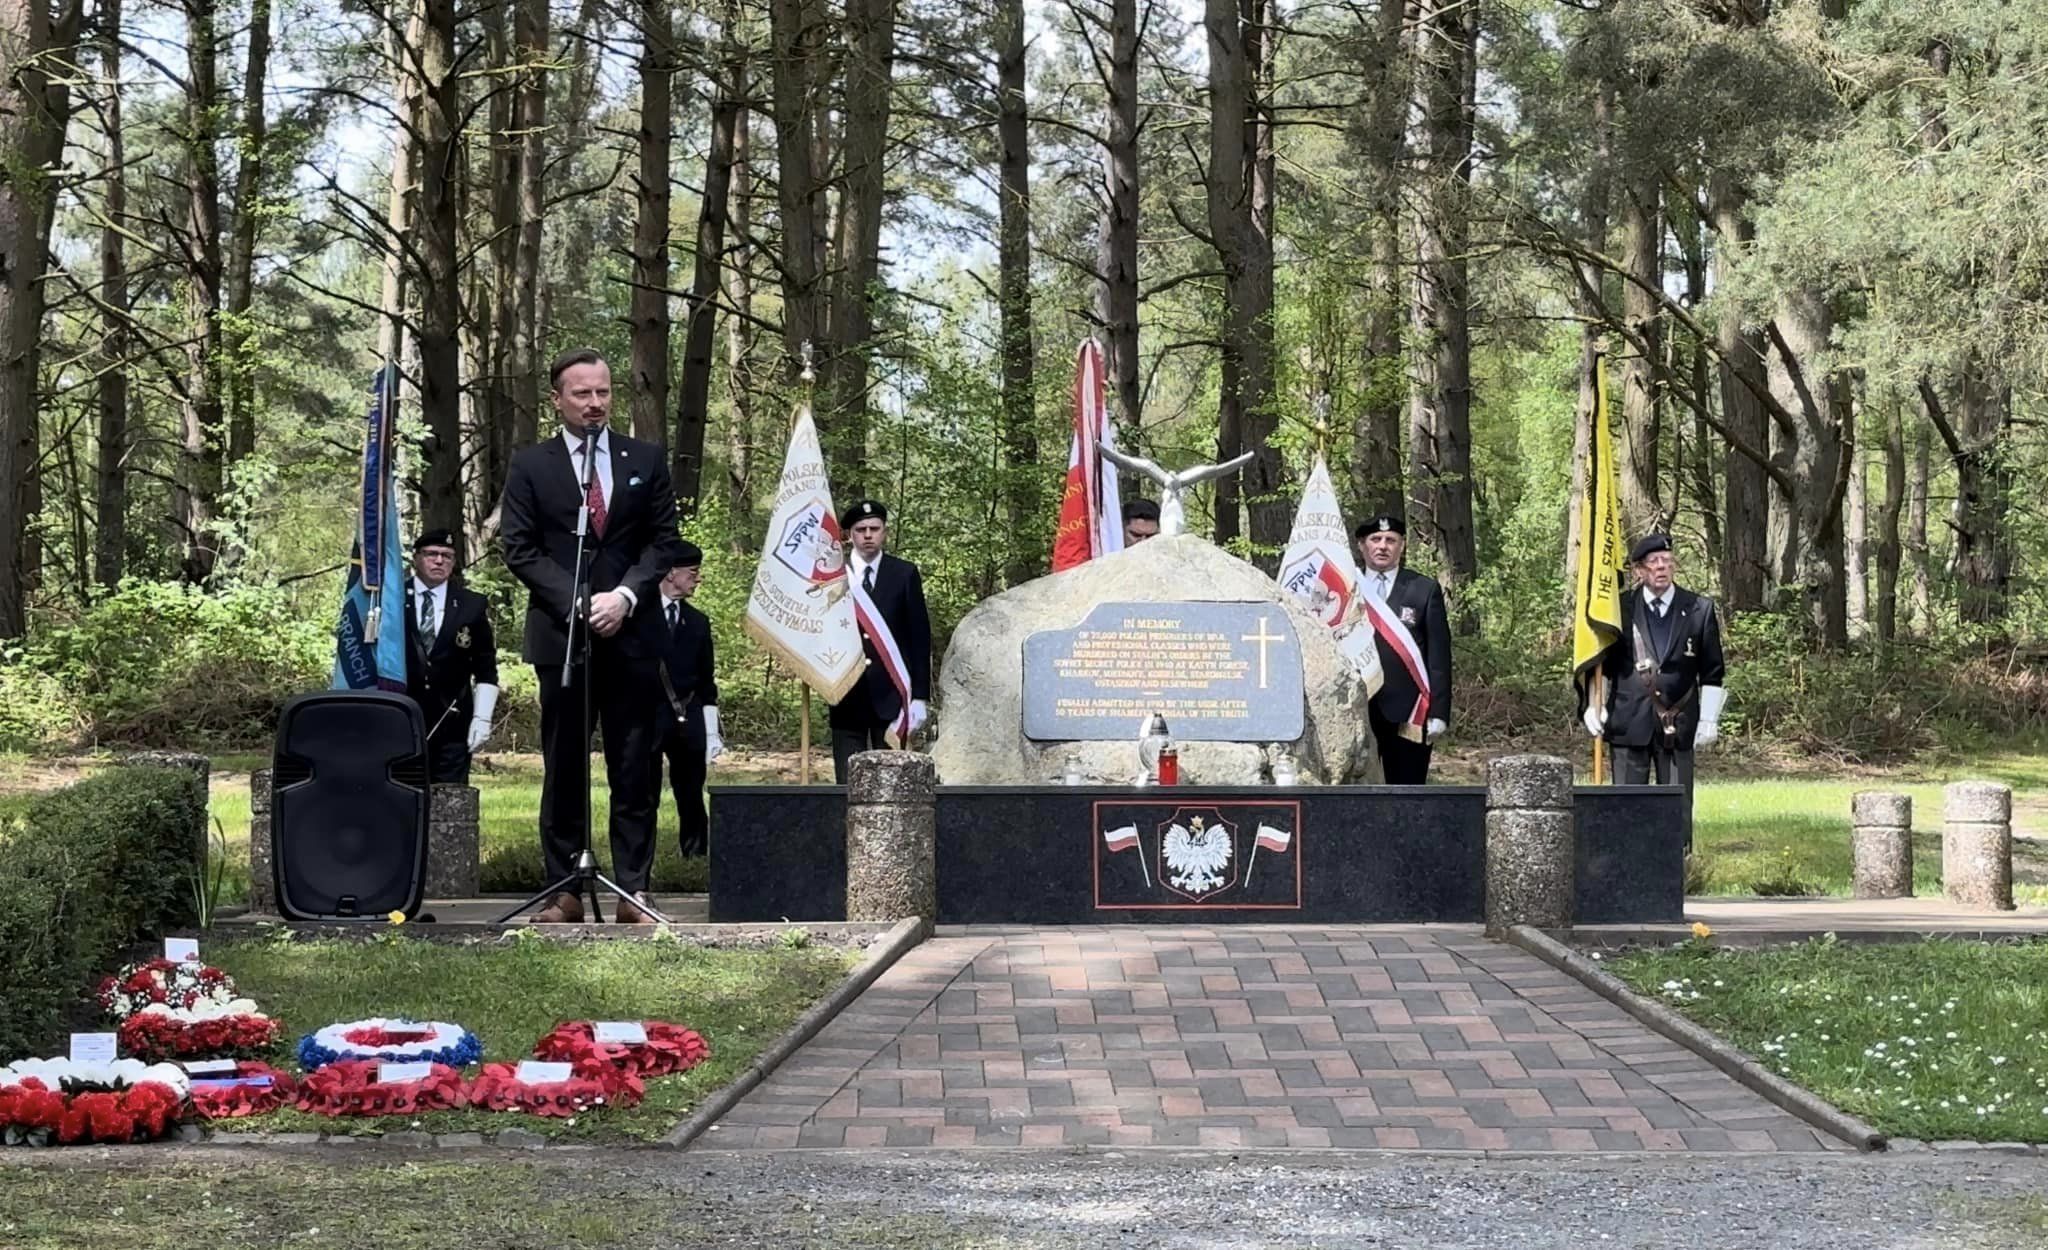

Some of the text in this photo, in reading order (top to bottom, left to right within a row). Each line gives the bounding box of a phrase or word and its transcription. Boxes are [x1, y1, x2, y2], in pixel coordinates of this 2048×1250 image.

[784, 512, 820, 554] SPPW
[1596, 573, 1613, 602] THE
[1123, 618, 1181, 629] IN MEMORY
